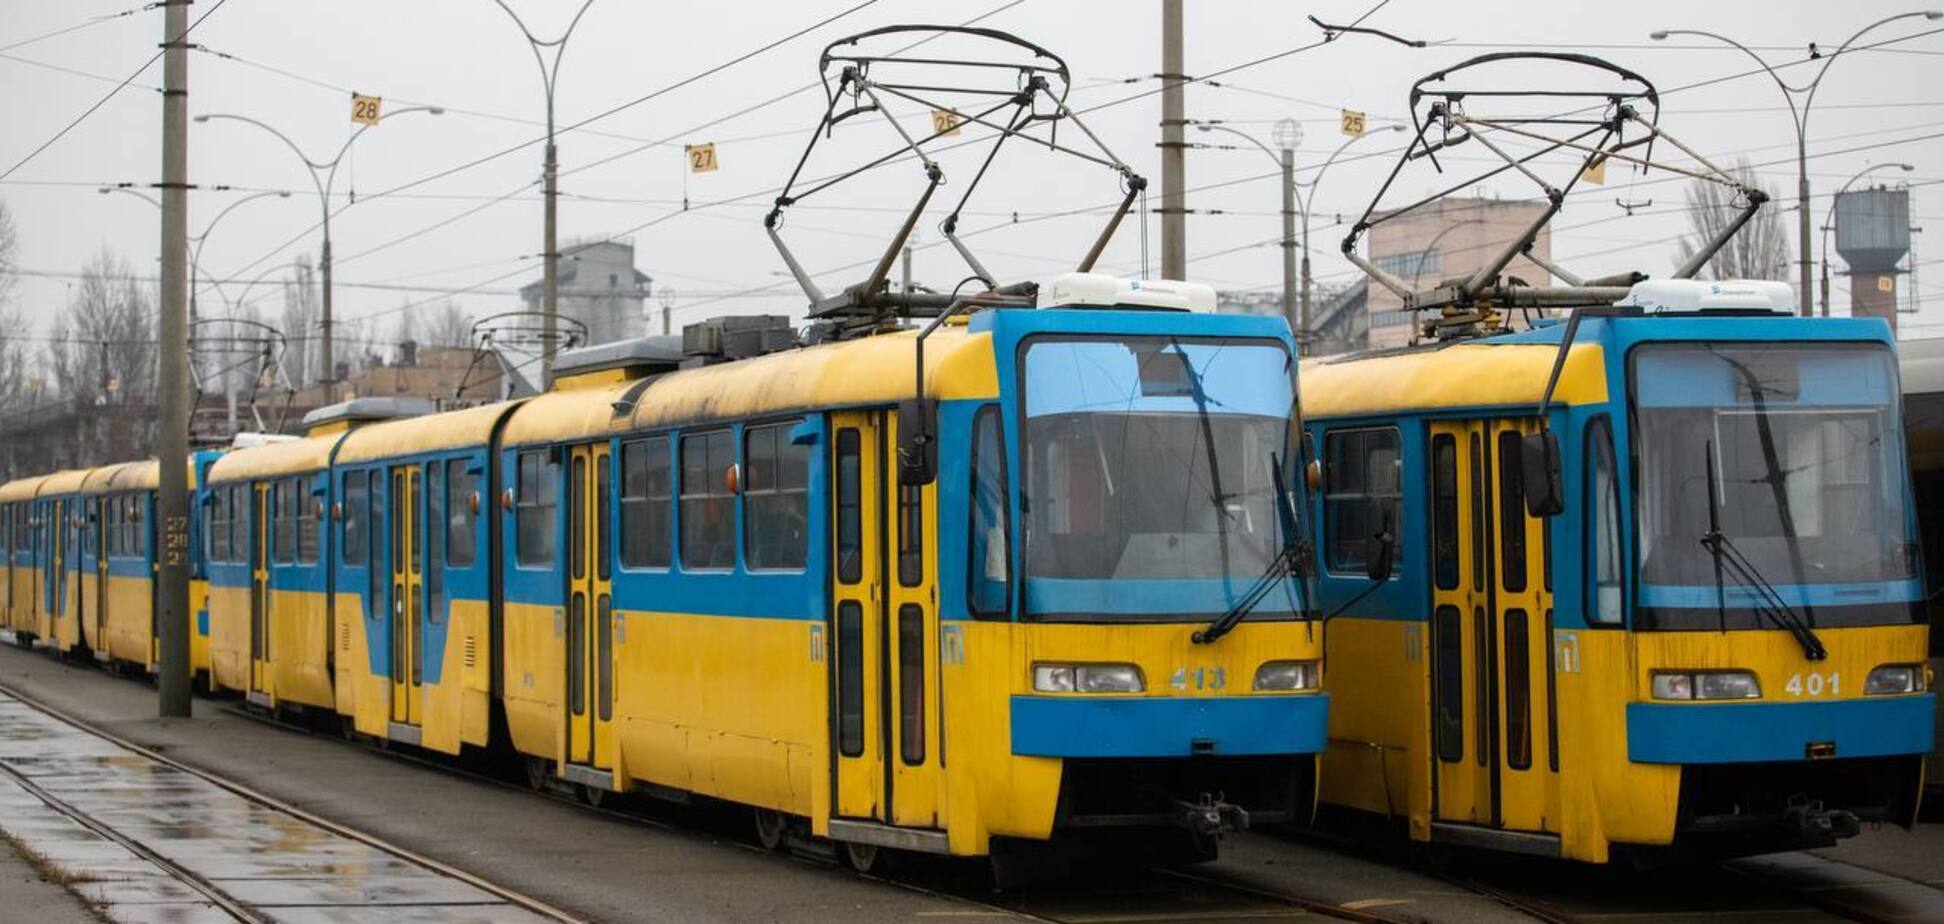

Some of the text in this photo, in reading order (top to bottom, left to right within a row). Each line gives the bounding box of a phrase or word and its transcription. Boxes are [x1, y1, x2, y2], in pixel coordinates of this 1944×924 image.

[356, 101, 377, 120] 28
[936, 114, 957, 134] 26
[1344, 115, 1363, 133] 25
[692, 149, 712, 168] 27
[167, 516, 187, 531] 27
[1170, 667, 1226, 690] 413
[1786, 672, 1840, 695] 401
